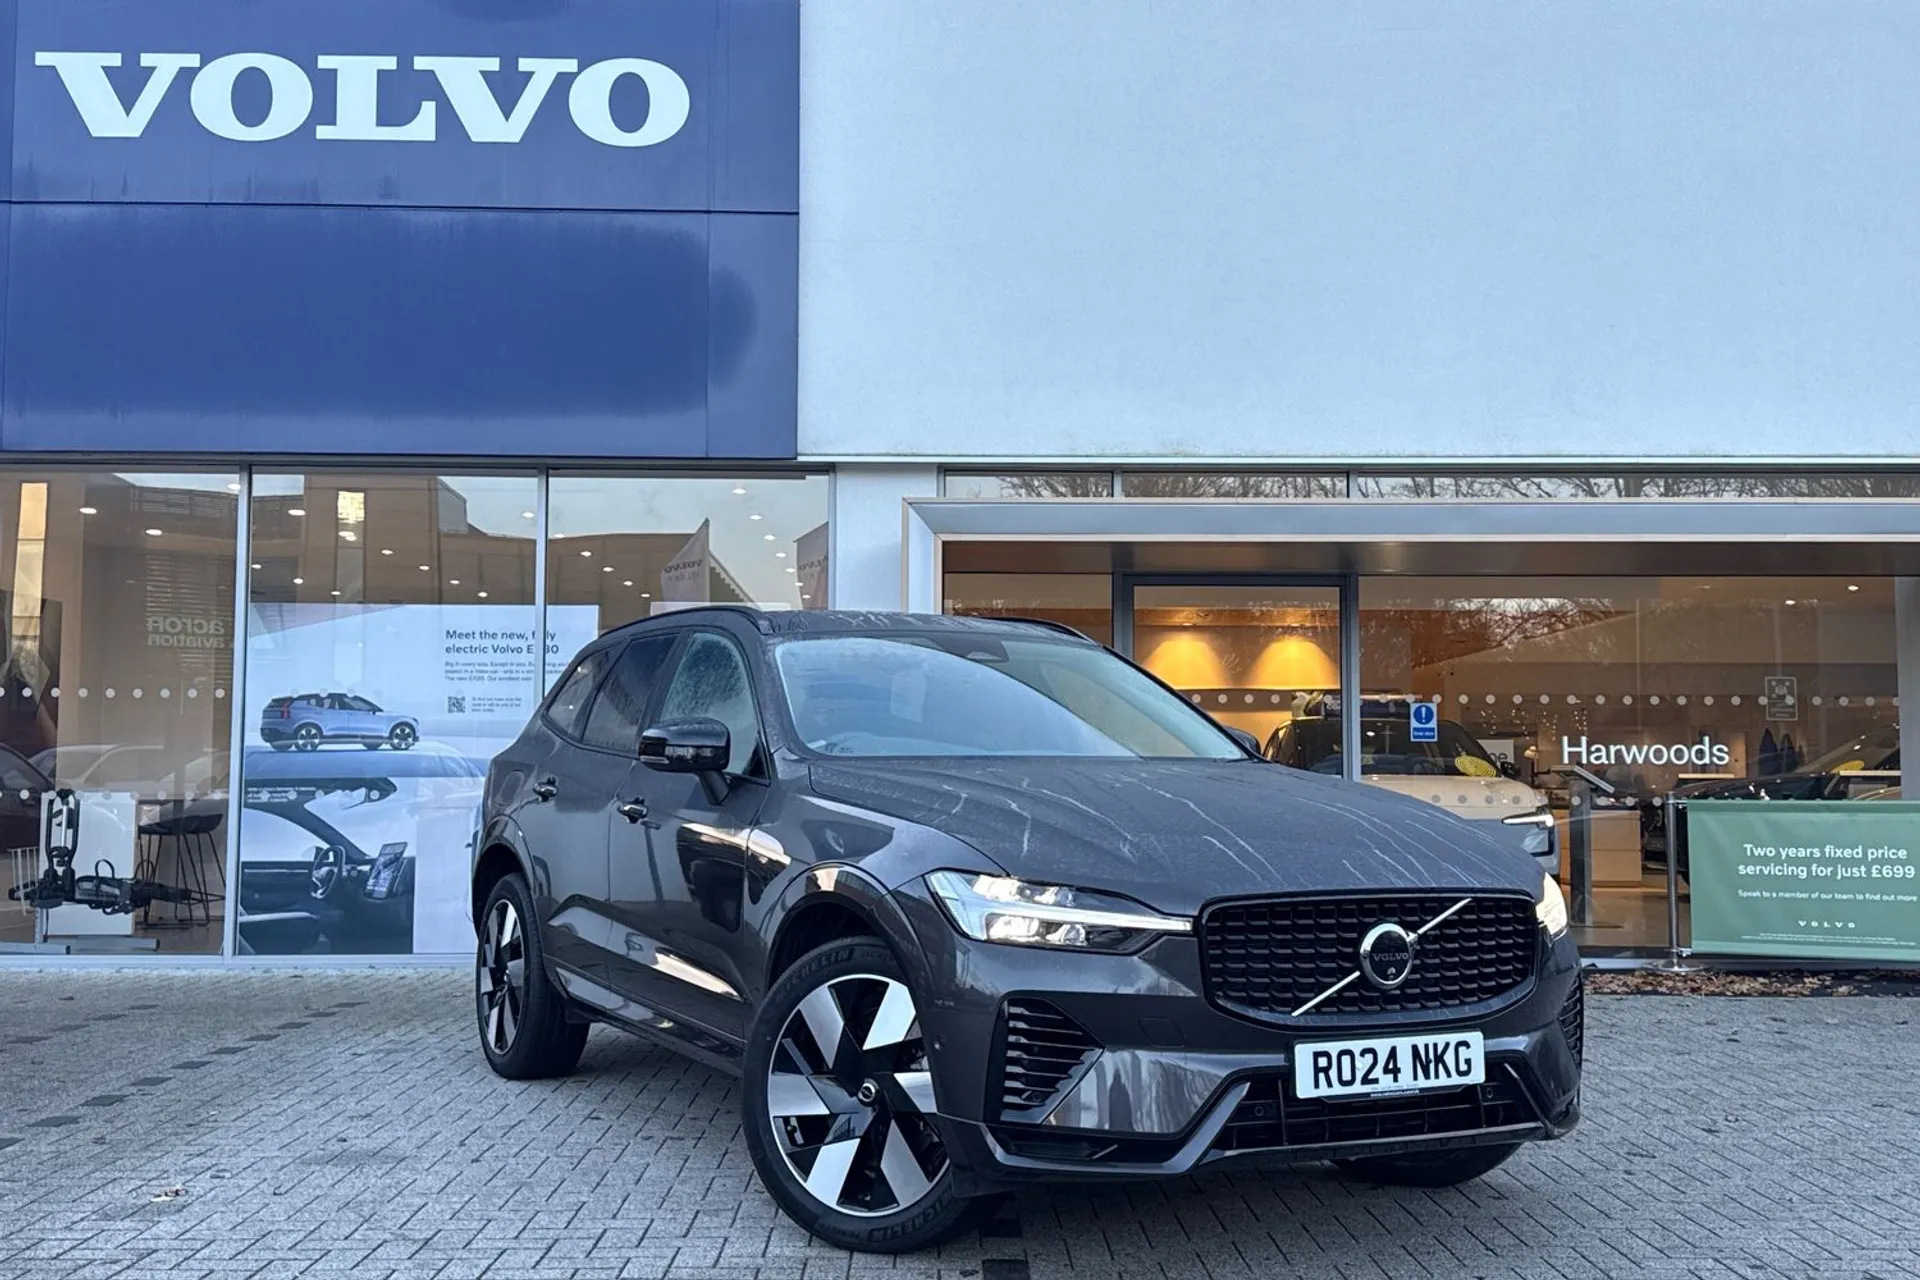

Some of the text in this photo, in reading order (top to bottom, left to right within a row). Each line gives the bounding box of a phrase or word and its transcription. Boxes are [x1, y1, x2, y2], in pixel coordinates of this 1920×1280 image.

[35, 51, 690, 147] VOLVO
[445, 630, 476, 639] Meet
[479, 630, 498, 639] the
[501, 631, 528, 641] new,
[445, 644, 559, 654] electric Volvo E30
[1562, 736, 1729, 765] Harwoods
[1743, 844, 1907, 861] Two years fixed price
[1738, 863, 1915, 880] servicing for just £699
[1738, 889, 1761, 898] Speak
[1778, 891, 1809, 899] member
[1811, 891, 1819, 899] of
[1834, 892, 1855, 900] team
[1798, 920, 1855, 928] VOLVO
[1372, 951, 1409, 962] VOLVO
[1312, 1040, 1472, 1089] RO24 NKG
